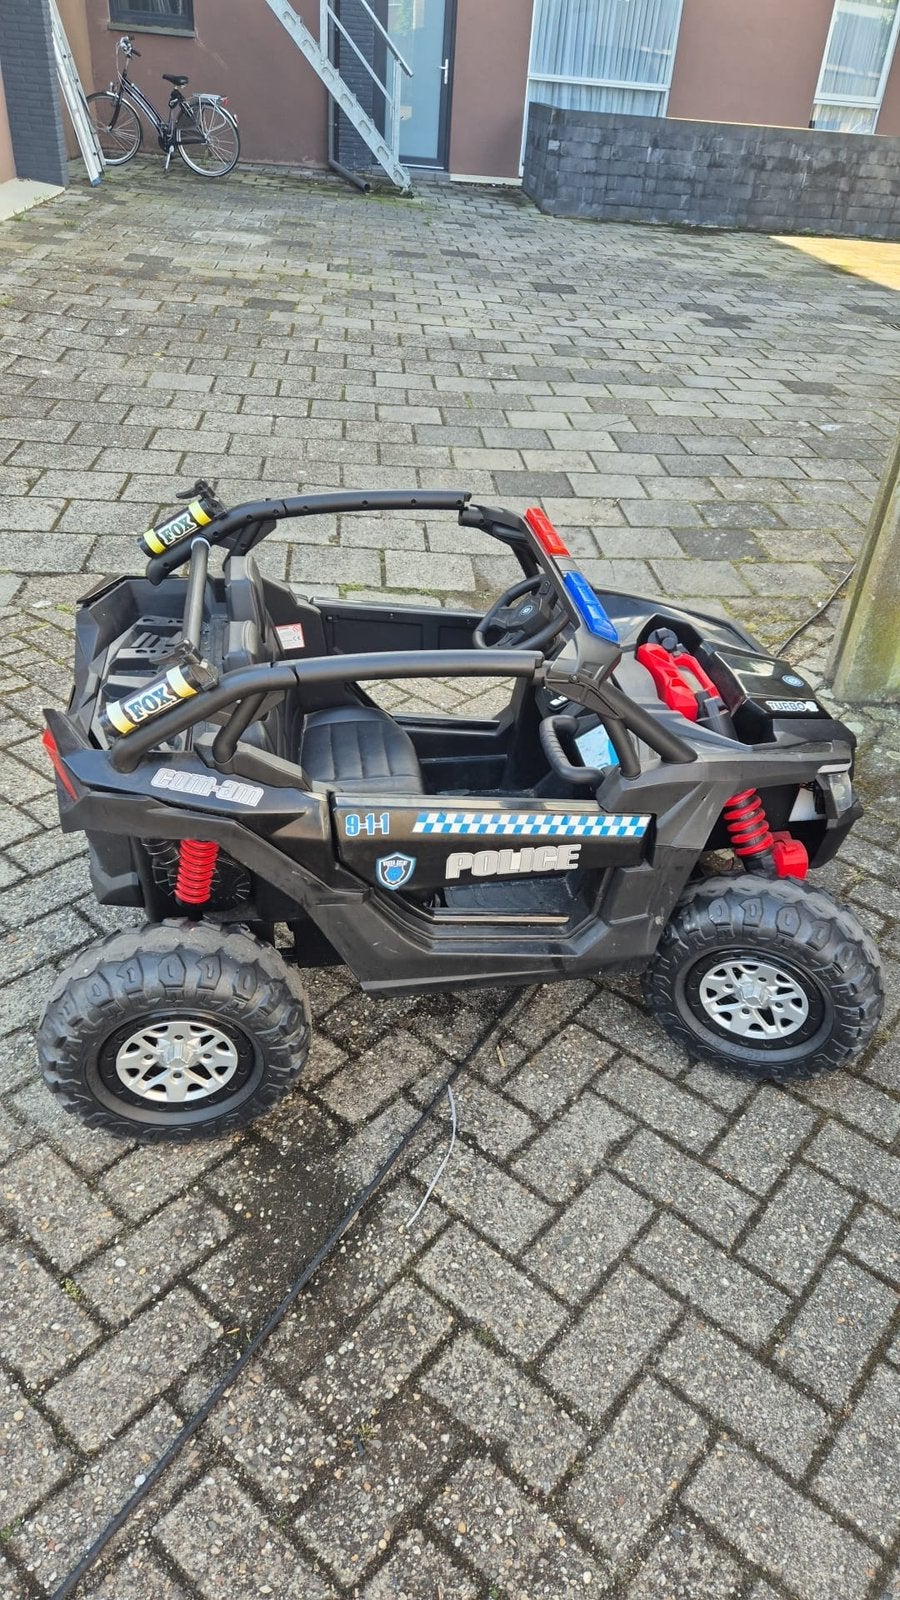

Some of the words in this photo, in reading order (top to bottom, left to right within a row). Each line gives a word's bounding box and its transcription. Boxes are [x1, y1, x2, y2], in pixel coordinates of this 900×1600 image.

[159, 514, 196, 544] FOX
[127, 686, 174, 720] FOX
[766, 701, 805, 712] TURBO
[445, 844, 582, 880] POLICE
